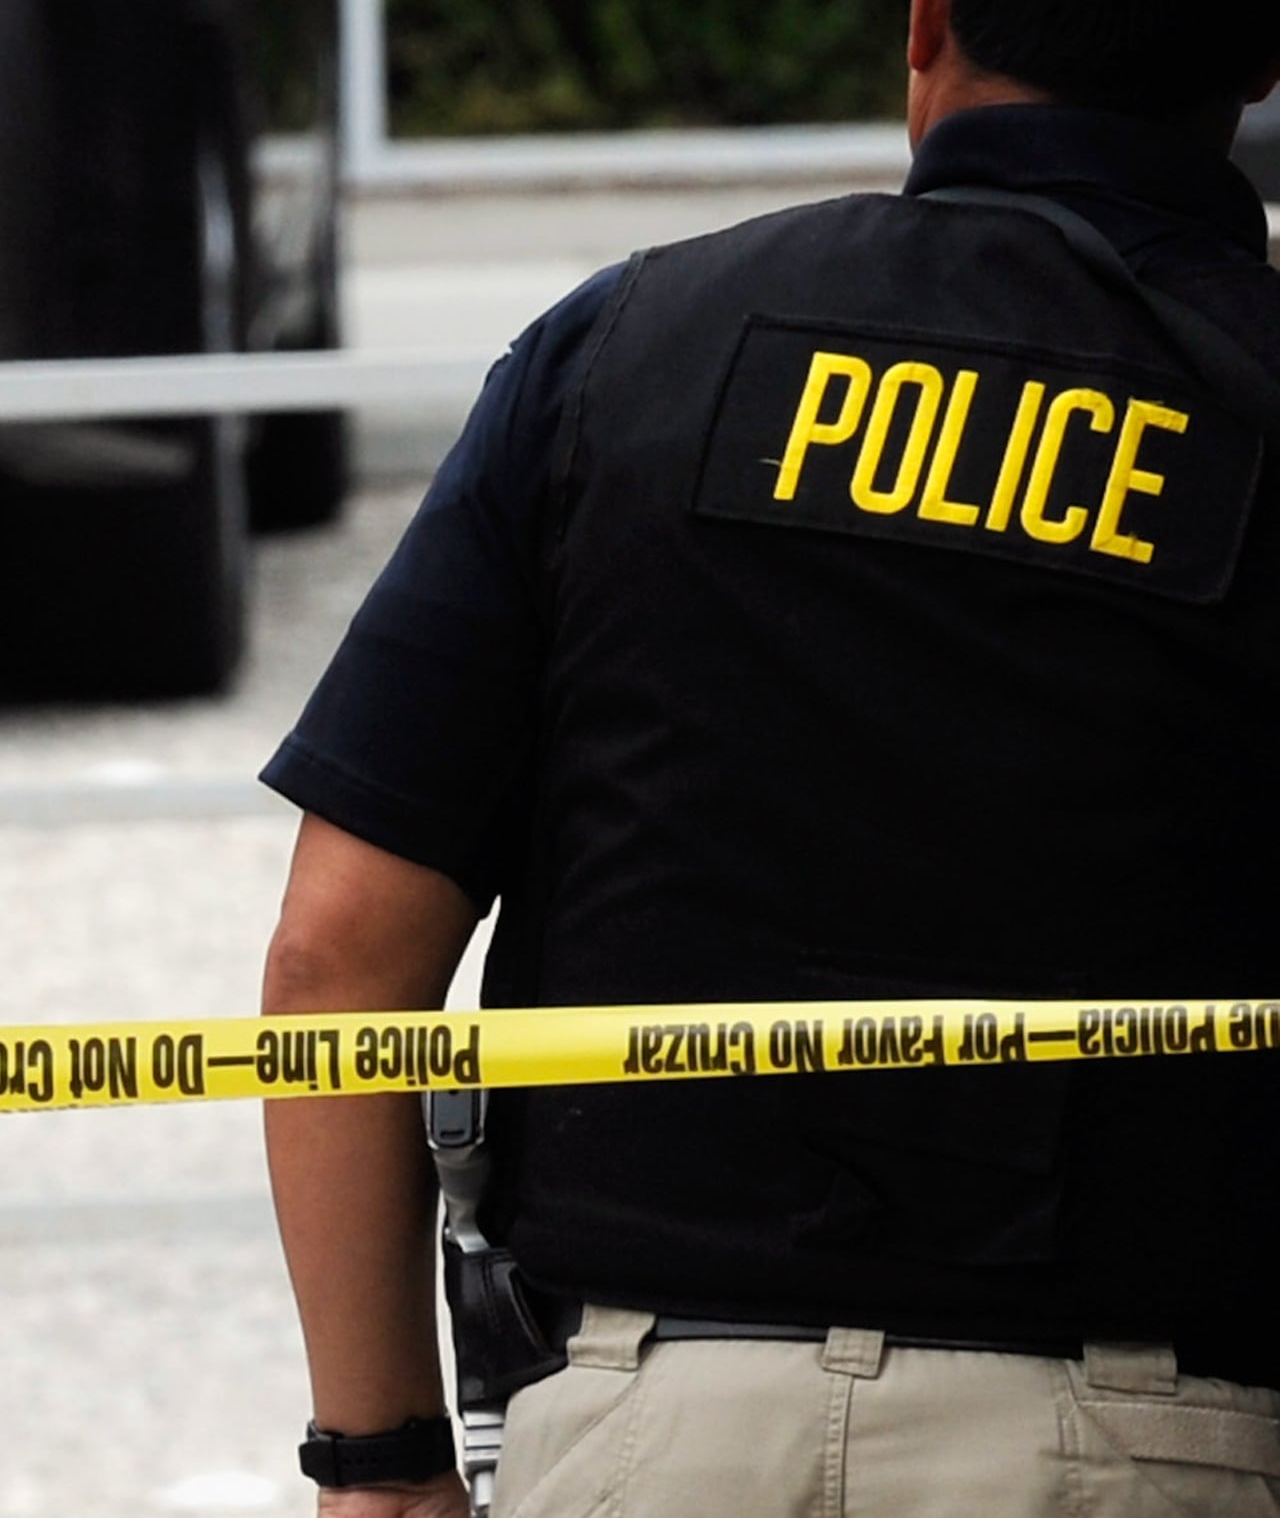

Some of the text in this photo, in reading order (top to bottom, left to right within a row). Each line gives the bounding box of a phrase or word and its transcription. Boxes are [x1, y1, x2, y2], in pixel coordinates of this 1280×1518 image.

[774, 351, 1189, 563] POLICE
[69, 1037, 138, 1099] Not
[356, 1025, 481, 1085] Police
[623, 1023, 756, 1076] Cruzar
[768, 1019, 825, 1073] No
[837, 1014, 944, 1066] Favor
